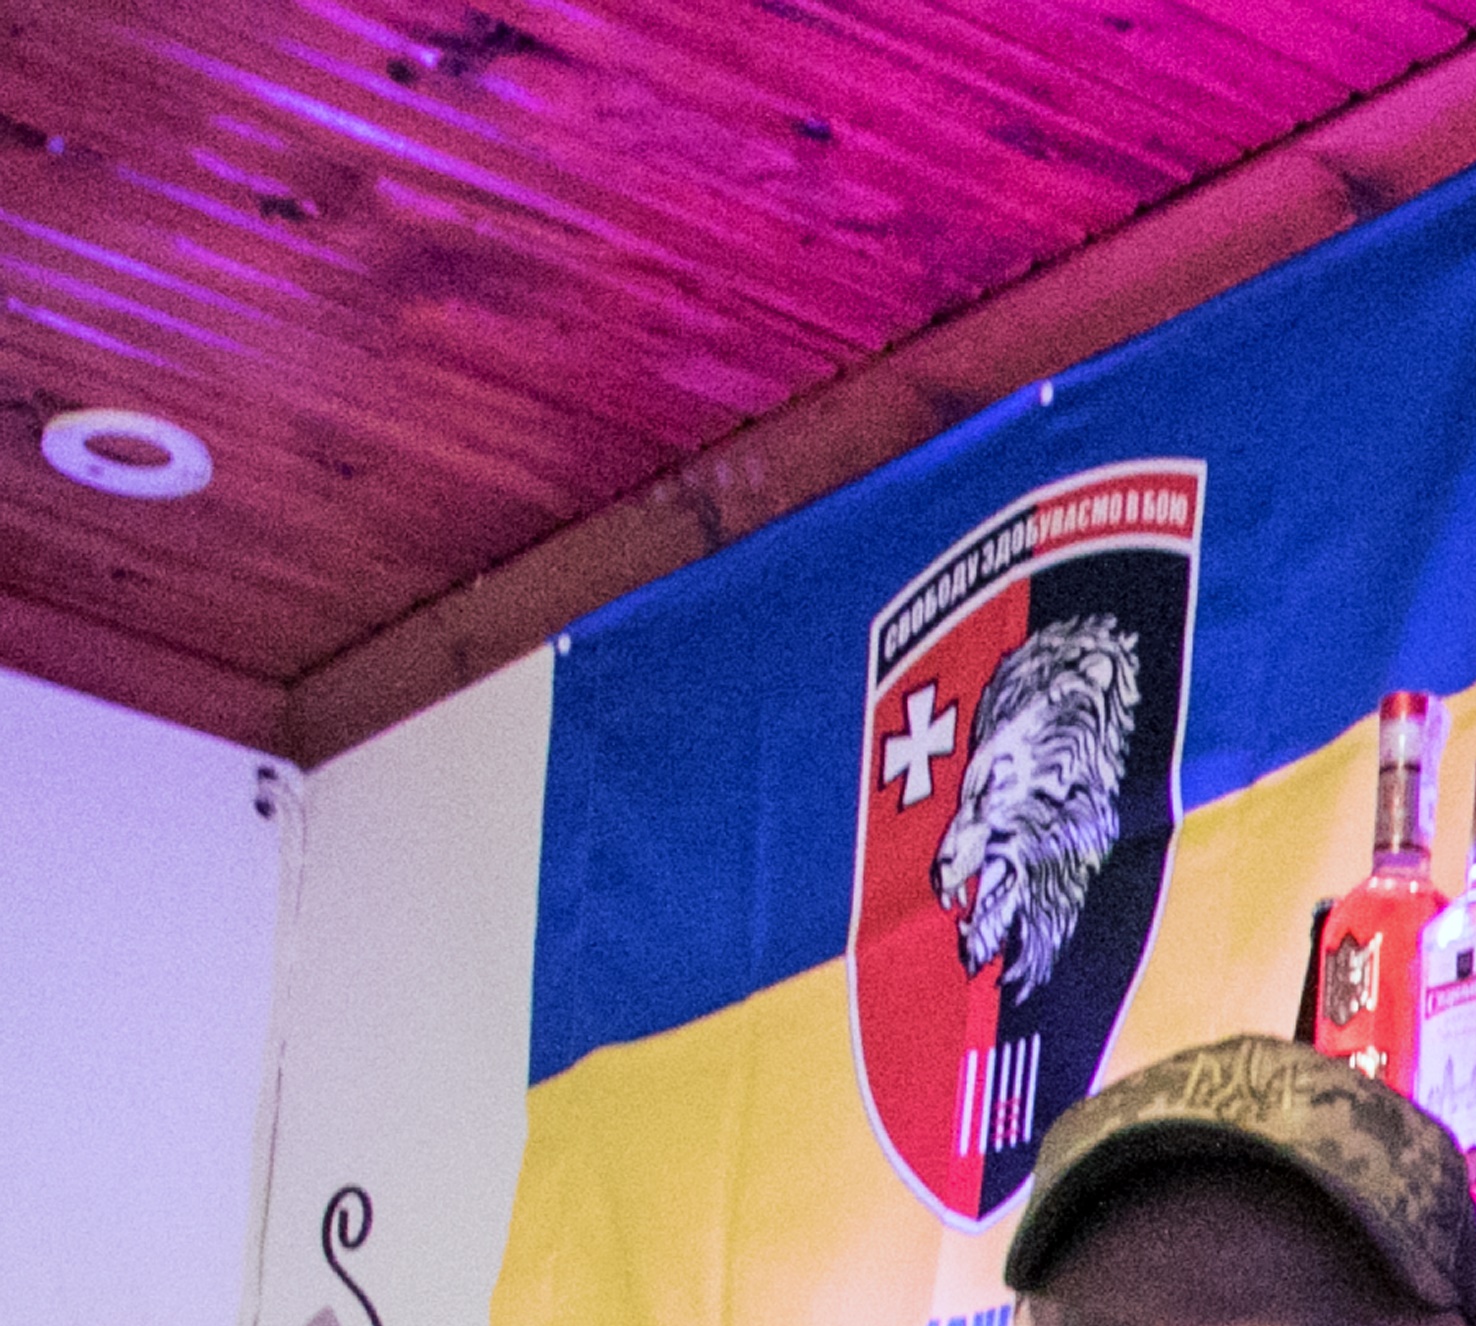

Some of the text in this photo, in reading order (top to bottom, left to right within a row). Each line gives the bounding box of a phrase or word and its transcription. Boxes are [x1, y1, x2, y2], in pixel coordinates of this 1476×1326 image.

[883, 552, 984, 662] СВОБОДУ
[979, 494, 1126, 578] ЗДОБУВАЄМО
[1143, 488, 1189, 524] БОЮ
